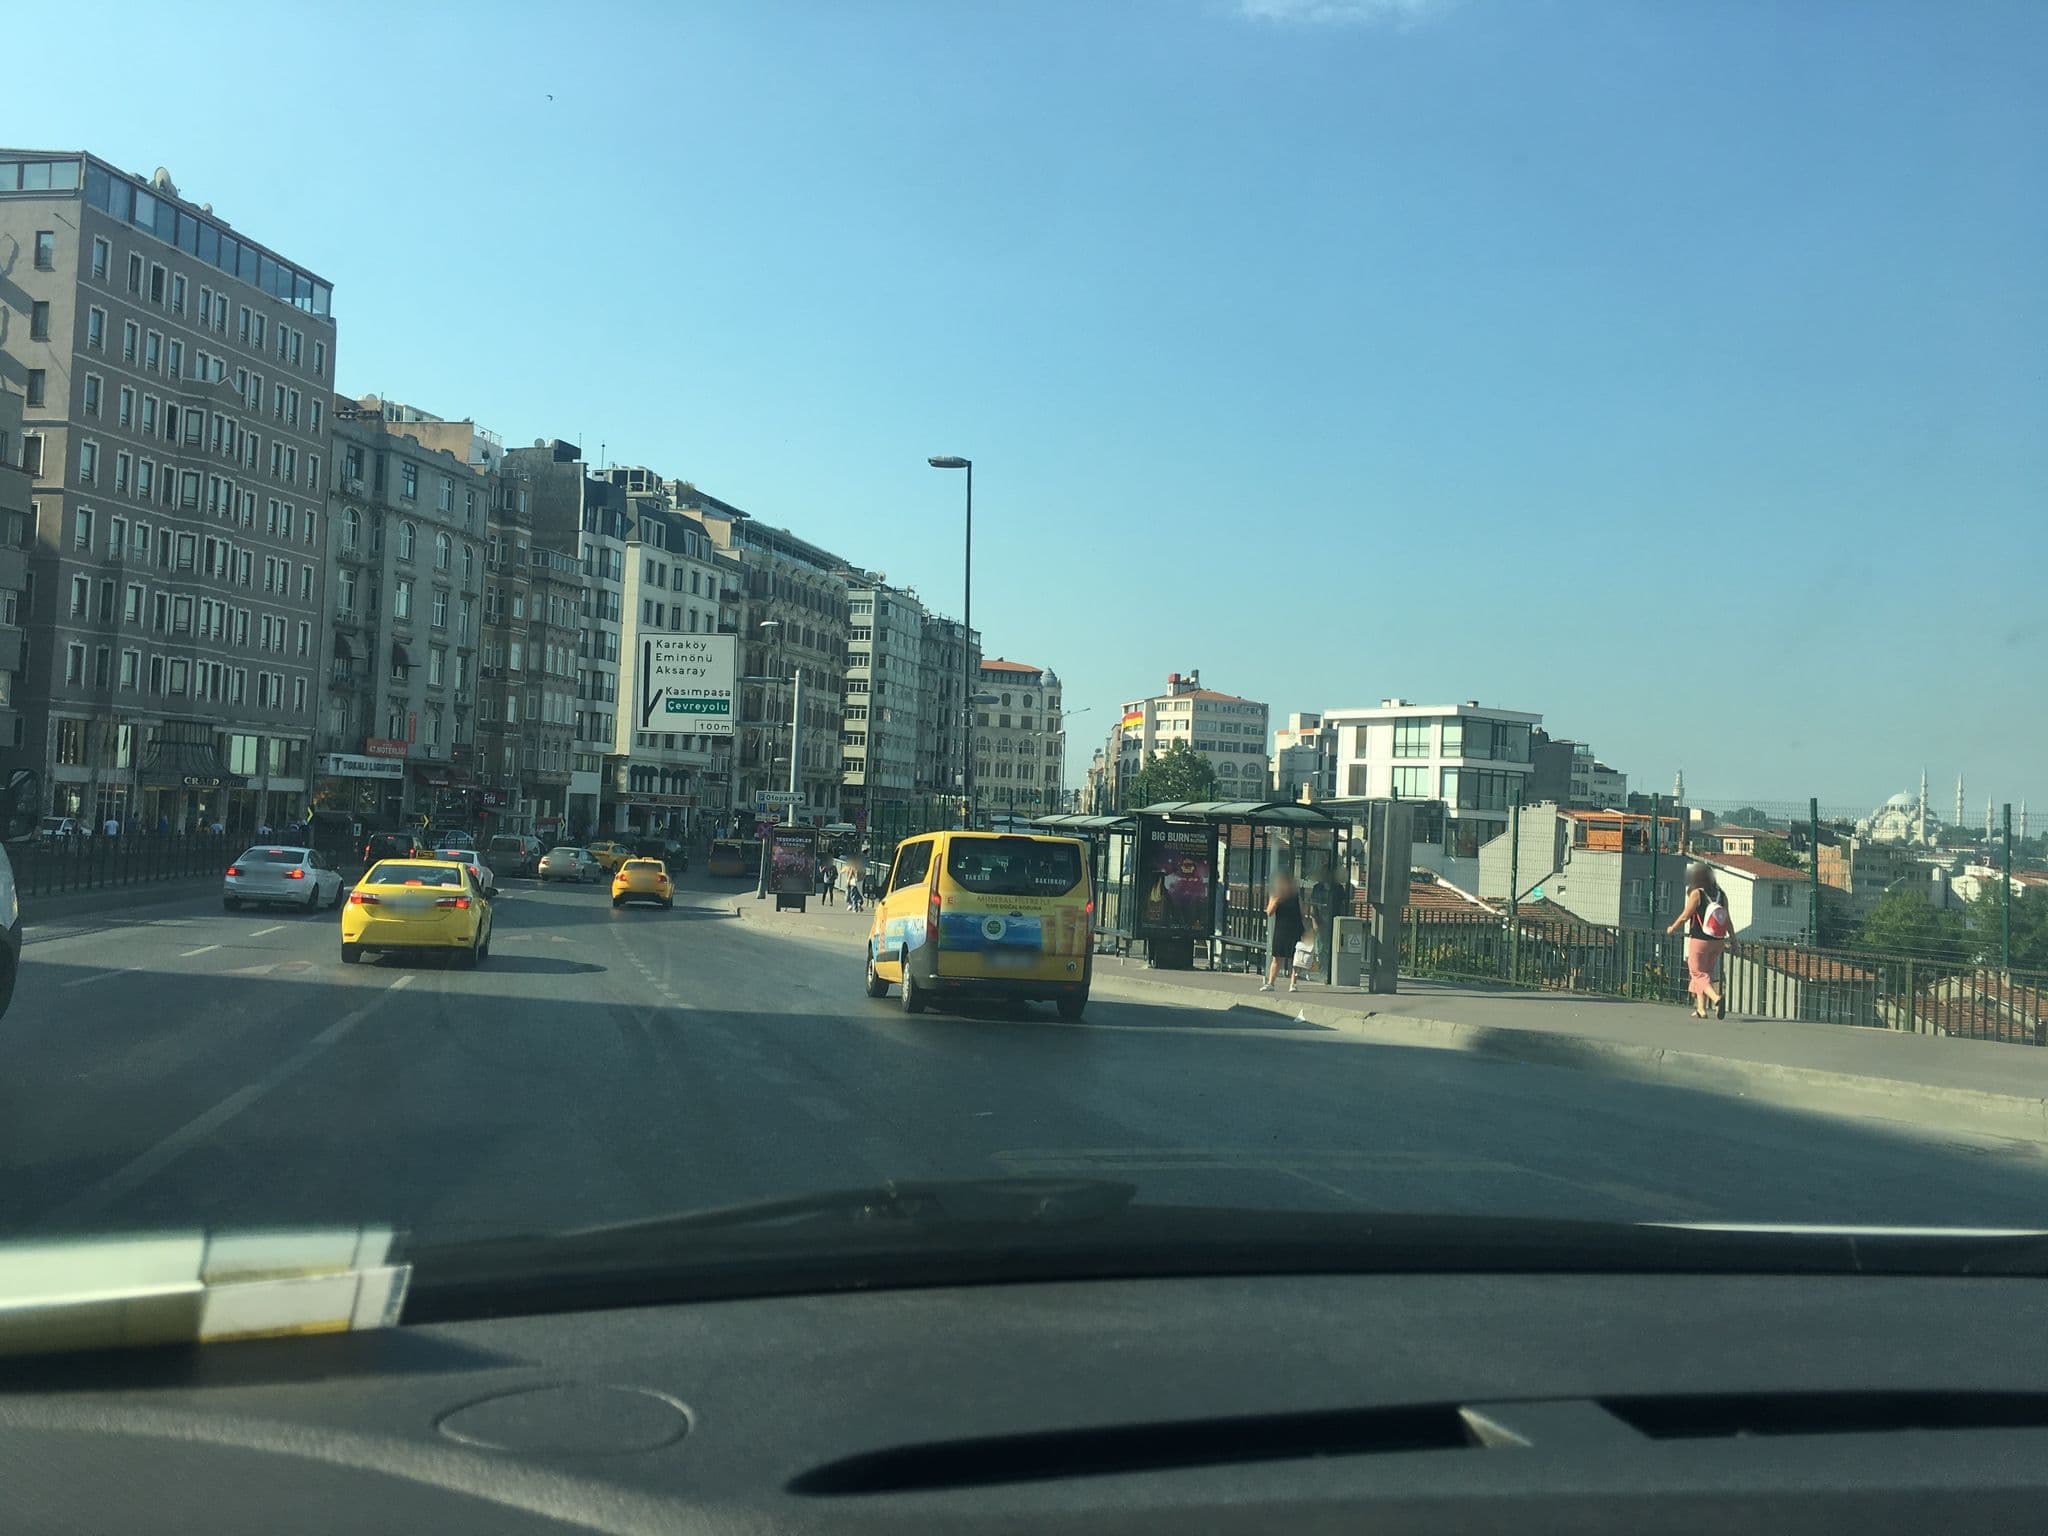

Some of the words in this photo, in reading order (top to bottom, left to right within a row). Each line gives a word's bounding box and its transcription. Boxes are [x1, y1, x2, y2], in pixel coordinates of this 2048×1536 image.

[656, 640, 707, 651] Karaköy
[656, 652, 712, 662] Eminönü
[656, 666, 706, 677] Aksaray
[665, 686, 731, 698] Kasımpaşa
[667, 701, 728, 713] Çevreyolu
[184, 776, 220, 786] GRD
[766, 794, 795, 802] Otopark
[1151, 831, 1166, 841] BIG
[1167, 832, 1190, 843] BURN
